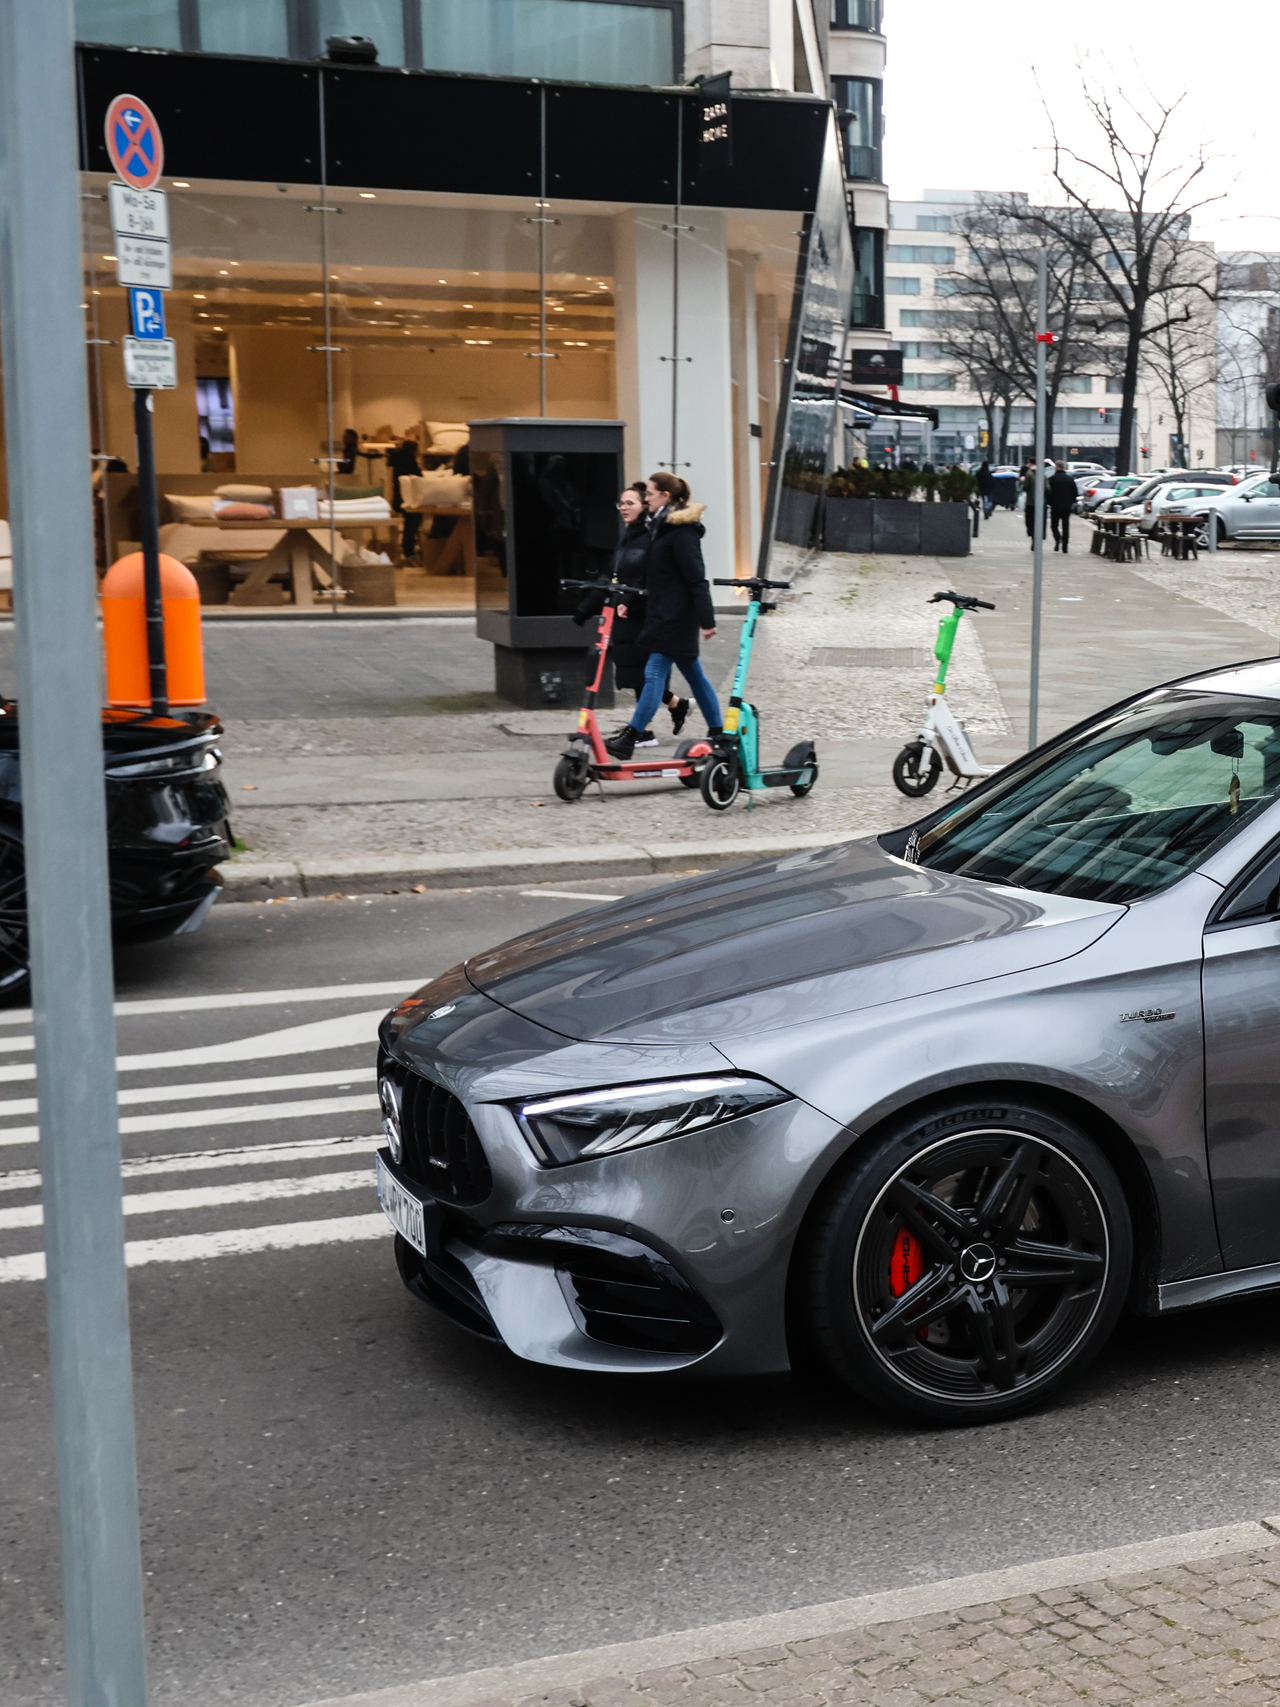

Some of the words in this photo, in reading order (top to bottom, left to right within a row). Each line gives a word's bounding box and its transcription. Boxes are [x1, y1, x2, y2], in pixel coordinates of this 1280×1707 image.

[703, 102, 727, 121] ZARA
[703, 124, 728, 142] HOME
[135, 291, 156, 333] P
[1119, 1007, 1163, 1020] TURBO
[923, 1108, 1004, 1136] MICHELIN
[902, 1237, 910, 1287] AMG
